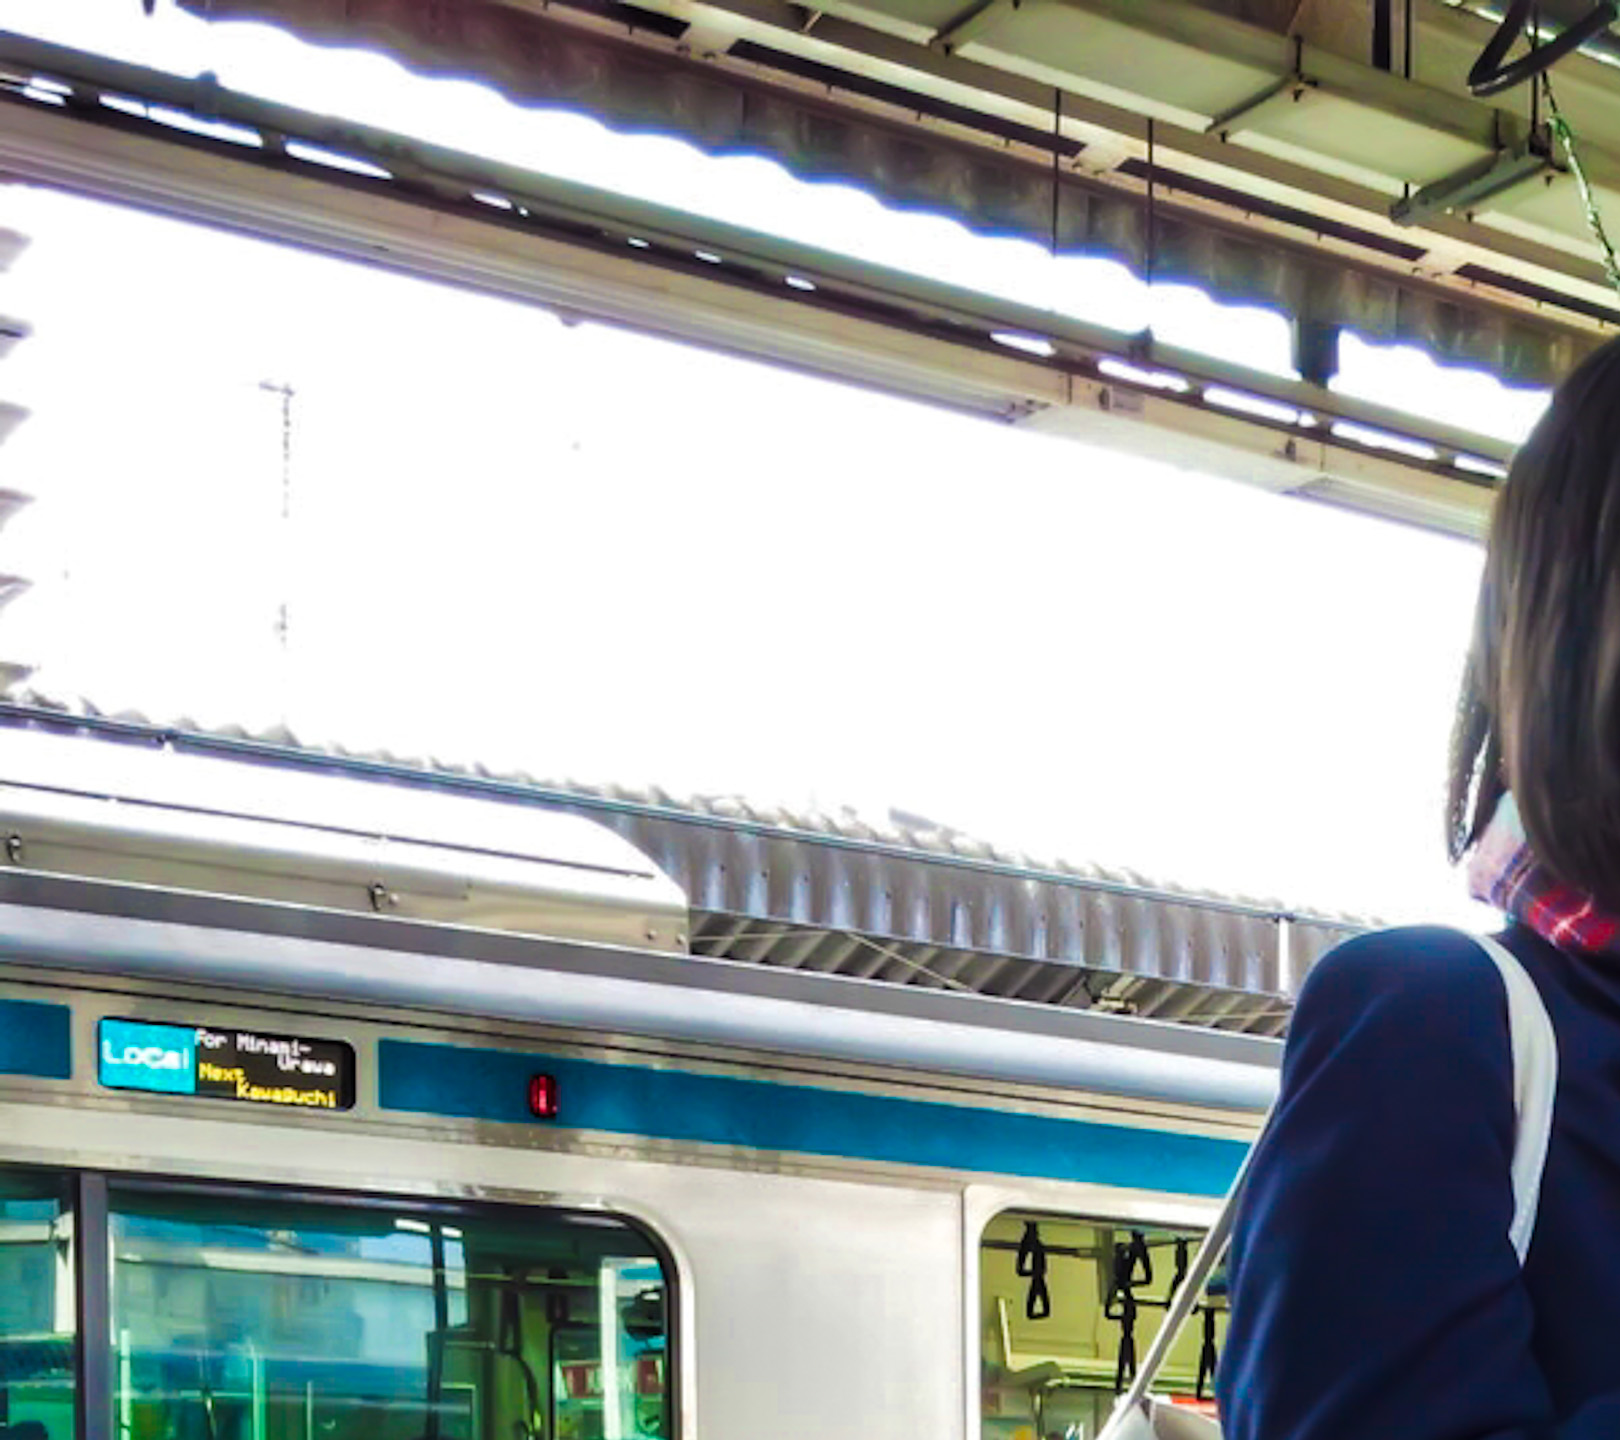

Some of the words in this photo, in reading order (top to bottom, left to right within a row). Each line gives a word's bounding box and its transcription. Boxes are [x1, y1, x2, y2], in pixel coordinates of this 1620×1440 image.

[102, 1039, 190, 1071] Local
[194, 1030, 228, 1048] For
[236, 1034, 312, 1057] Minami-
[198, 1062, 244, 1082] Next
[276, 1054, 336, 1076] Urawa
